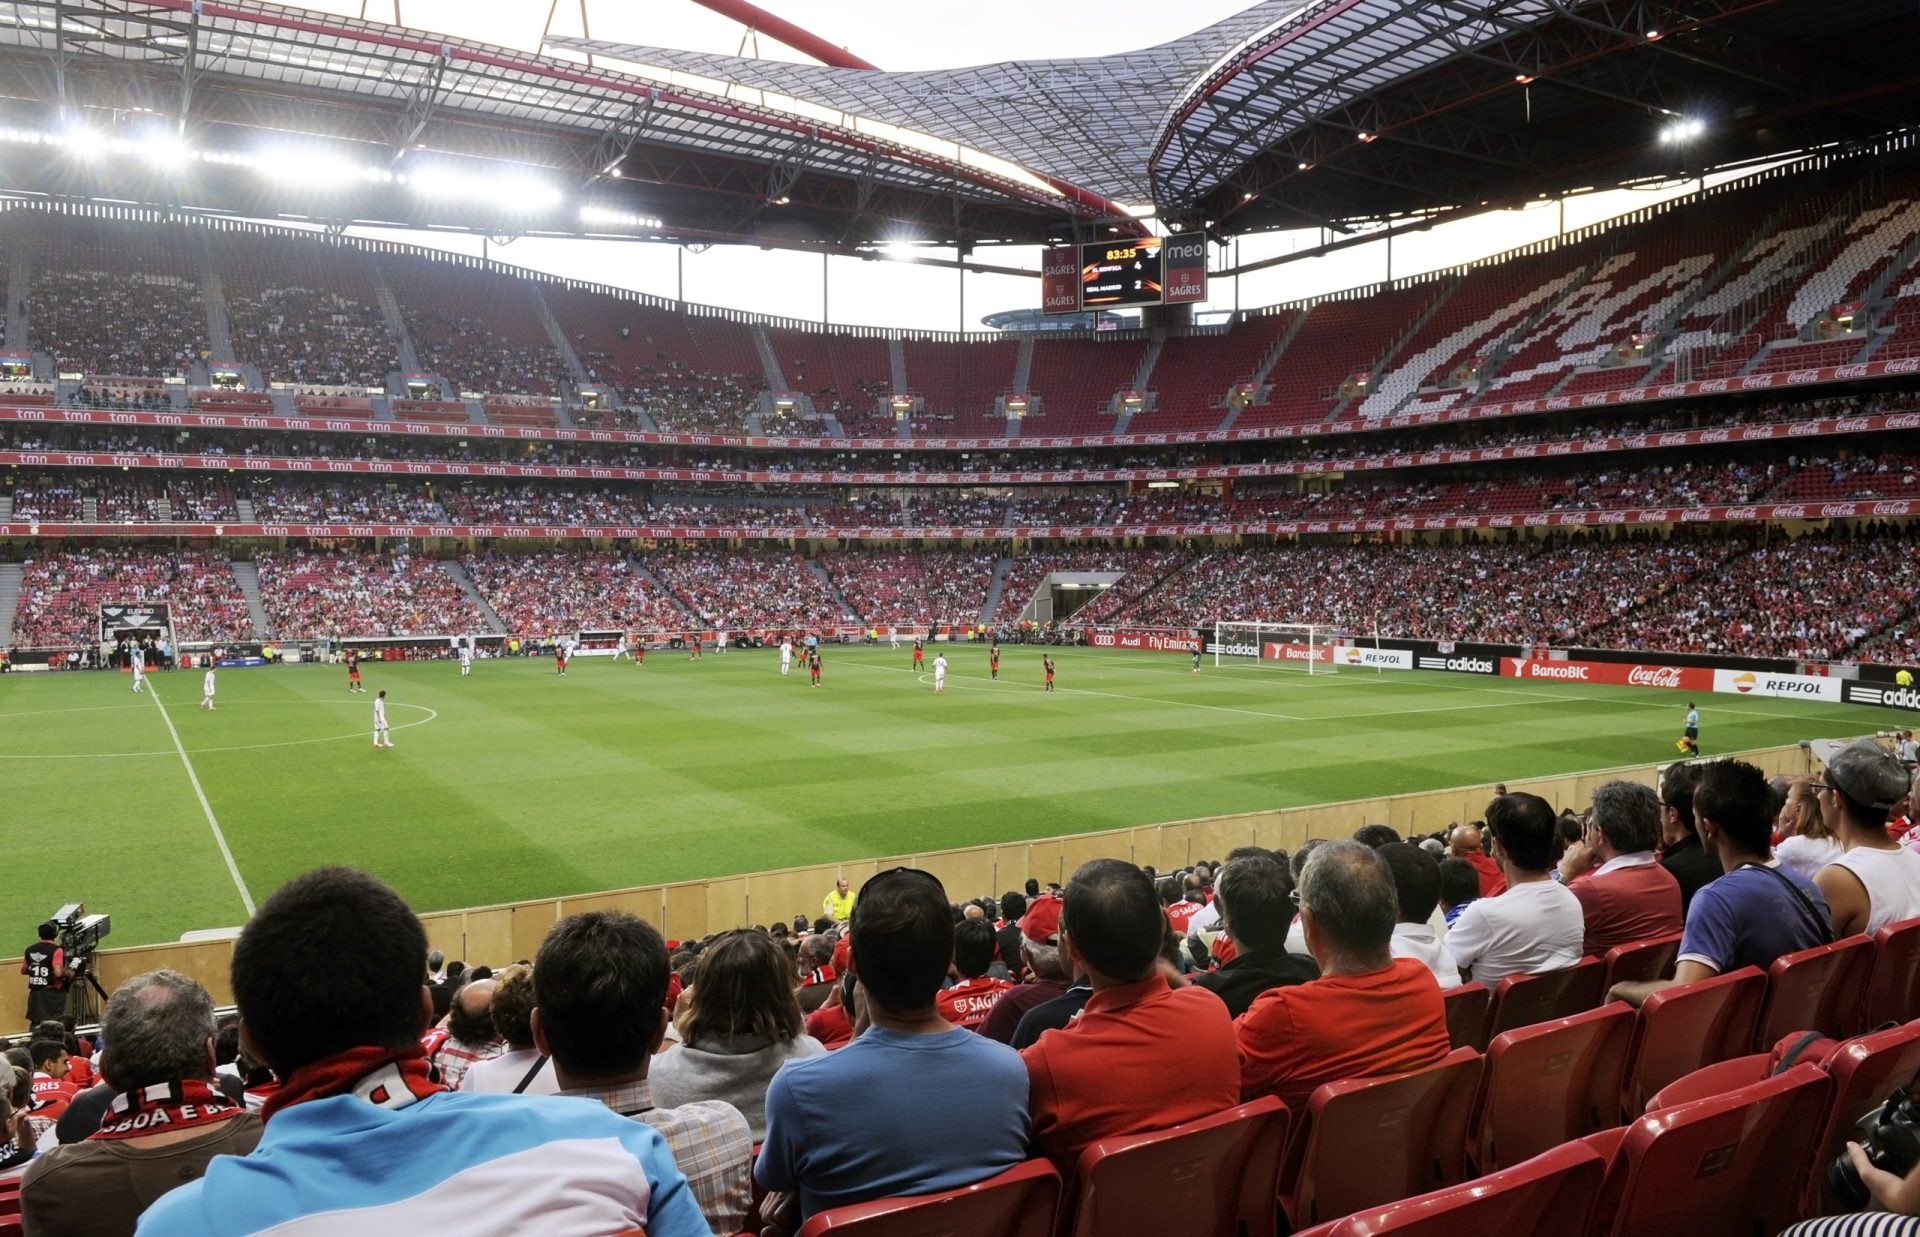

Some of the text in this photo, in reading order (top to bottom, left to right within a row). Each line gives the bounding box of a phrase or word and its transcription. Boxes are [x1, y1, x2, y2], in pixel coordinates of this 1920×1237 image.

[1106, 248, 1136, 260] 83:35
[1167, 244, 1203, 259] meo
[1045, 264, 1075, 276] SAGRES
[1134, 280, 1142, 289] 2
[1170, 284, 1201, 297] SAGRES
[1046, 296, 1075, 307] SAGRES
[16, 409, 742, 446] tmn tmn tmn tmn tmn tmn tmn tmn tmn tmn tmn tmn tmn tmn tmn tmn tmn tmn tmn
[19, 452, 47, 464] tmn
[66, 454, 93, 465] tmn
[112, 455, 139, 466] tmn
[201, 457, 227, 468] tmn
[245, 458, 270, 469] tmn
[287, 459, 311, 470] tmn
[328, 460, 352, 471] tmn
[369, 461, 392, 472] tmn
[407, 462, 431, 473] tmn
[446, 464, 468, 474] tmn
[483, 465, 505, 475] tmn
[520, 465, 541, 475] tmn
[556, 466, 576, 476] tmn
[591, 467, 611, 477] tmn
[625, 469, 644, 479] tmn
[658, 470, 678, 480] tmn
[691, 470, 710, 480] tmn
[723, 471, 741, 481] tmn
[262, 525, 764, 538] tmn tmn tmn tmn tmn tmn tmn tmn tmn tmn tmn tmn tmn tmn
[1121, 637, 1140, 646] Audi
[1149, 637, 1162, 650] Fly
[1226, 643, 1259, 656] adidas
[1365, 653, 1400, 664] REPSOL
[1447, 656, 1493, 673] adidas
[1531, 664, 1589, 679] BancoBIC
[1766, 680, 1821, 694] REPSOL
